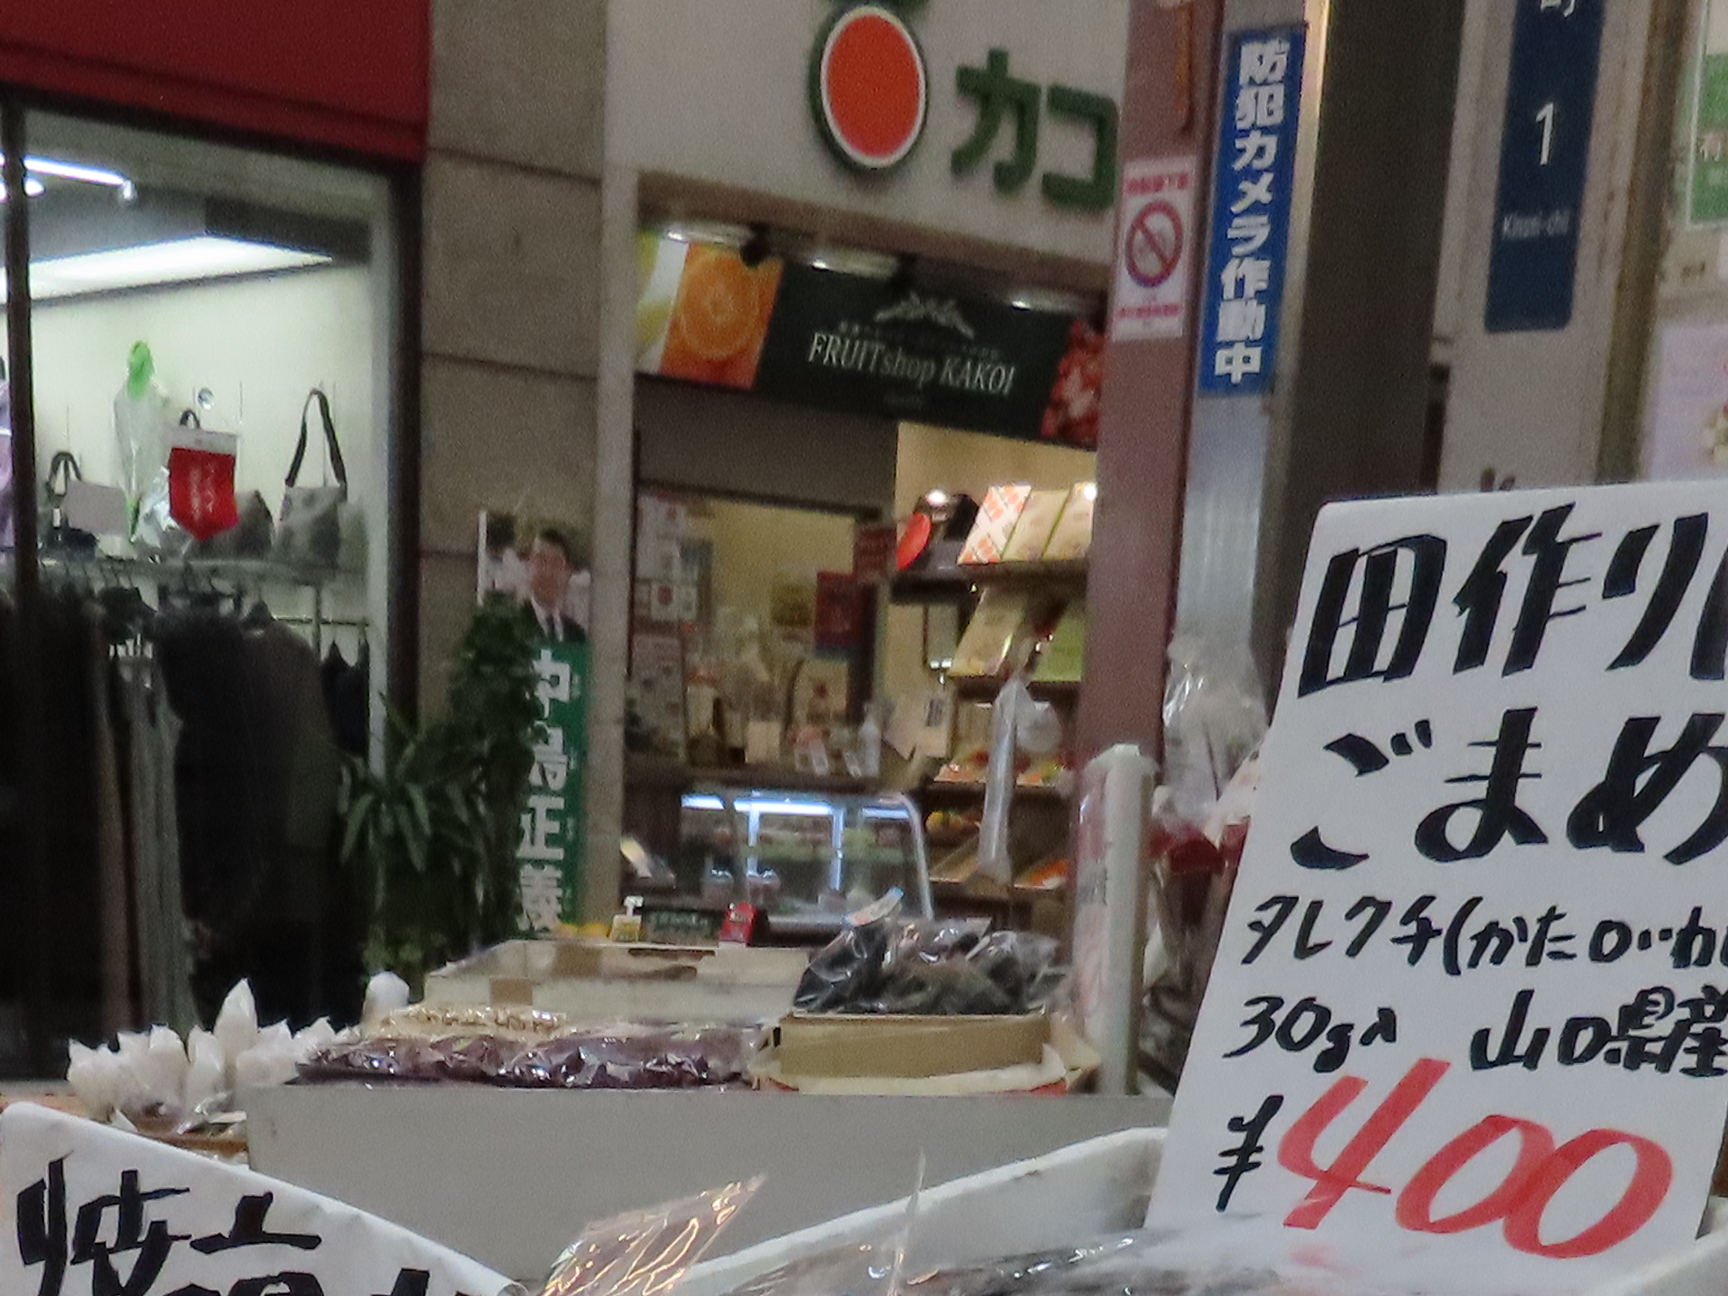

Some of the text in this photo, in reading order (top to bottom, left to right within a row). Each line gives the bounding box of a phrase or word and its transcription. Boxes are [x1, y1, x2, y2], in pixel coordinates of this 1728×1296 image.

[1535, 101, 1556, 166] 1
[1214, 38, 1291, 385] 防犯カメラ作動中
[939, 356, 1017, 396] KAKOI
[1222, 996, 1398, 1073] 30g入
[1213, 1056, 1672, 1260] ¥400
